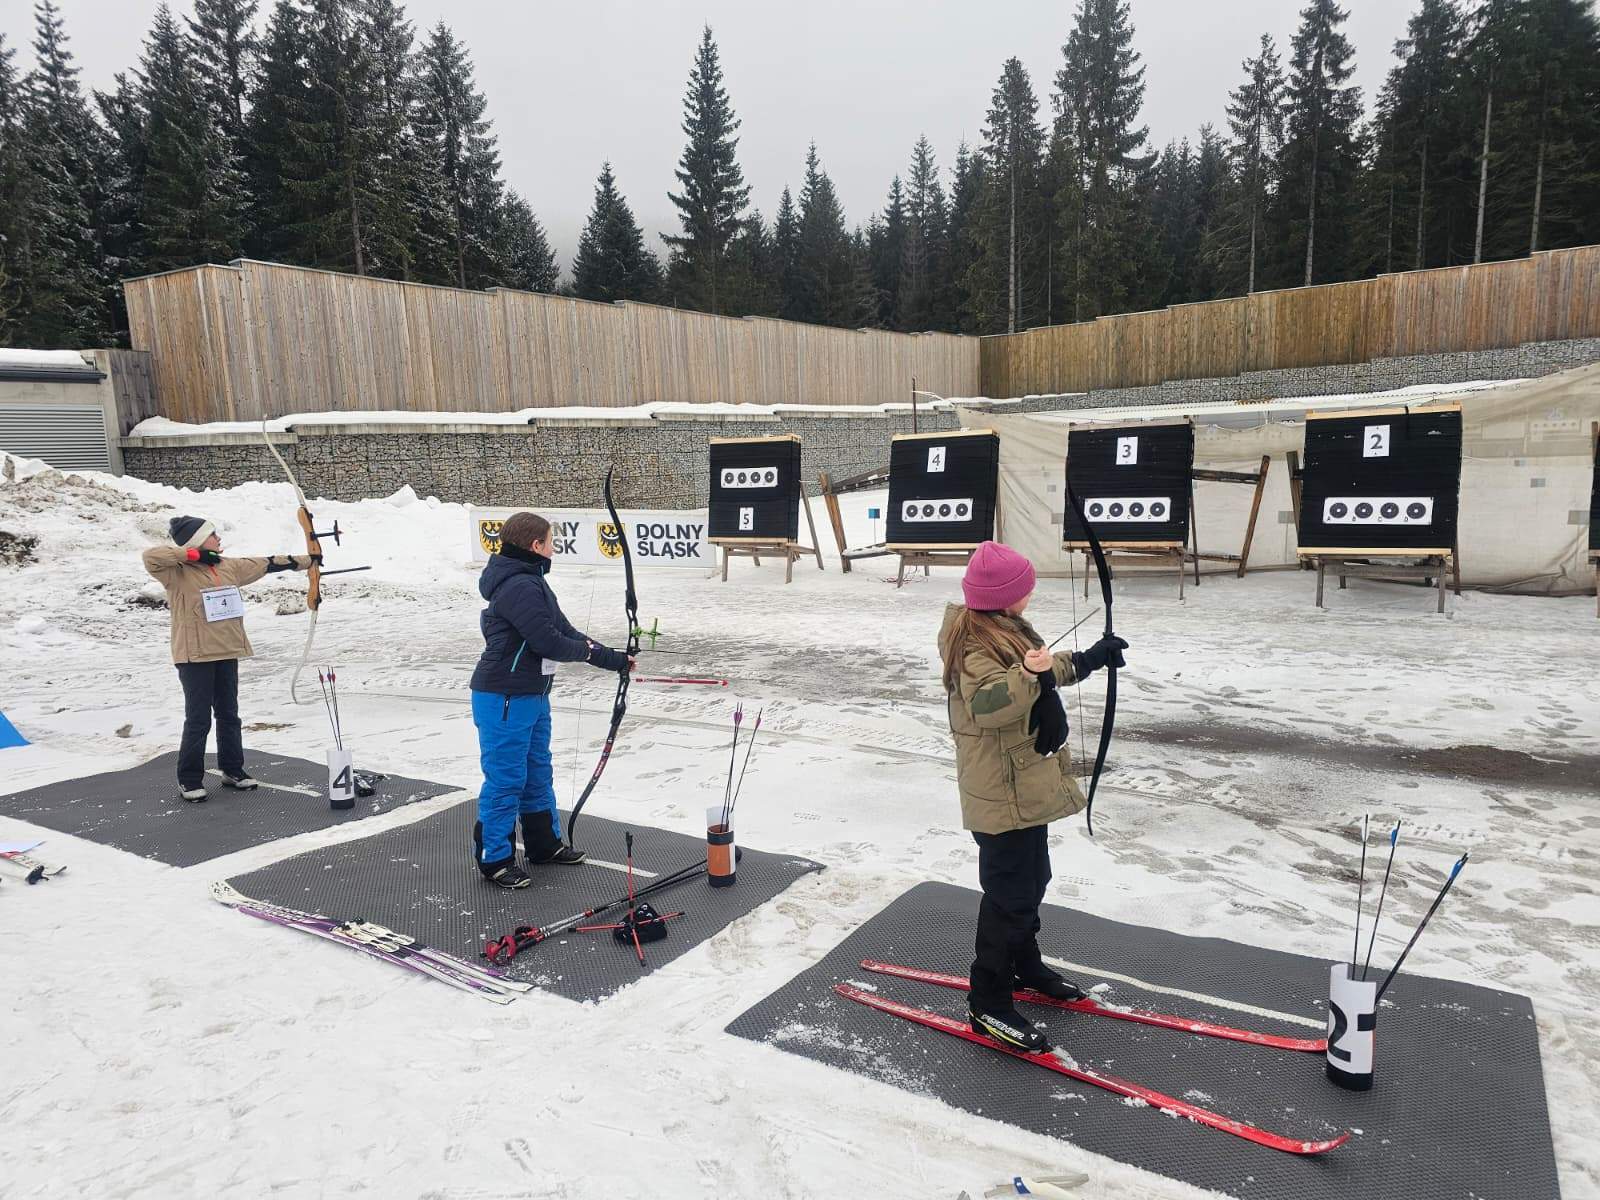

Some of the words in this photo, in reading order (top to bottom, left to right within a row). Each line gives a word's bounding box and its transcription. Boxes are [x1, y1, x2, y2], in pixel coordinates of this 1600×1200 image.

[1370, 433, 1383, 450] 2
[1122, 444, 1132, 458] 3
[932, 453, 941, 467] 4
[743, 513, 750, 525] 5
[636, 523, 704, 540] DOLNY
[637, 536, 701, 560] ŚLĄSK
[221, 598, 227, 607] 4
[333, 764, 353, 795] 4
